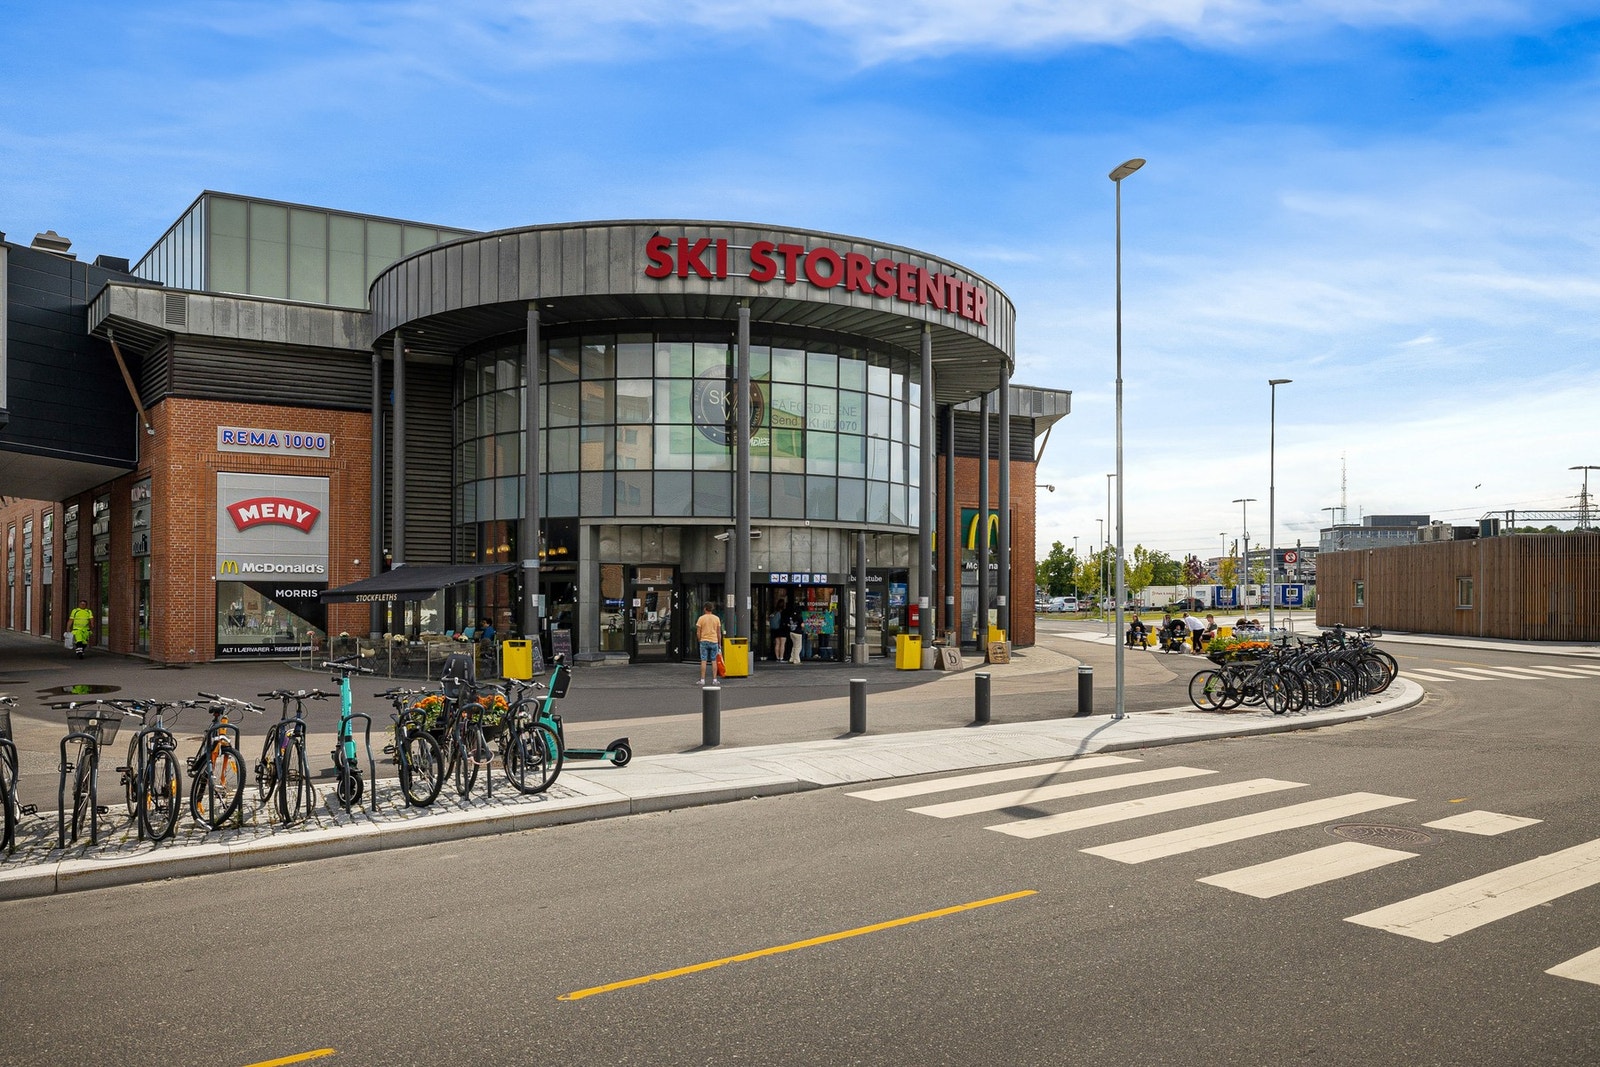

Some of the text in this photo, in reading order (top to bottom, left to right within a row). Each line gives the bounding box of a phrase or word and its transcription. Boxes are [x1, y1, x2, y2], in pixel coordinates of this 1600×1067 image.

[644, 236, 988, 327] SKI STORSENTER
[772, 414, 798, 426] Send
[222, 429, 326, 450] REMA 1000
[238, 503, 311, 523] MENY
[242, 562, 325, 574] McDonald's
[275, 589, 318, 598] MORRIS
[355, 593, 398, 602] STOCKFLETHS
